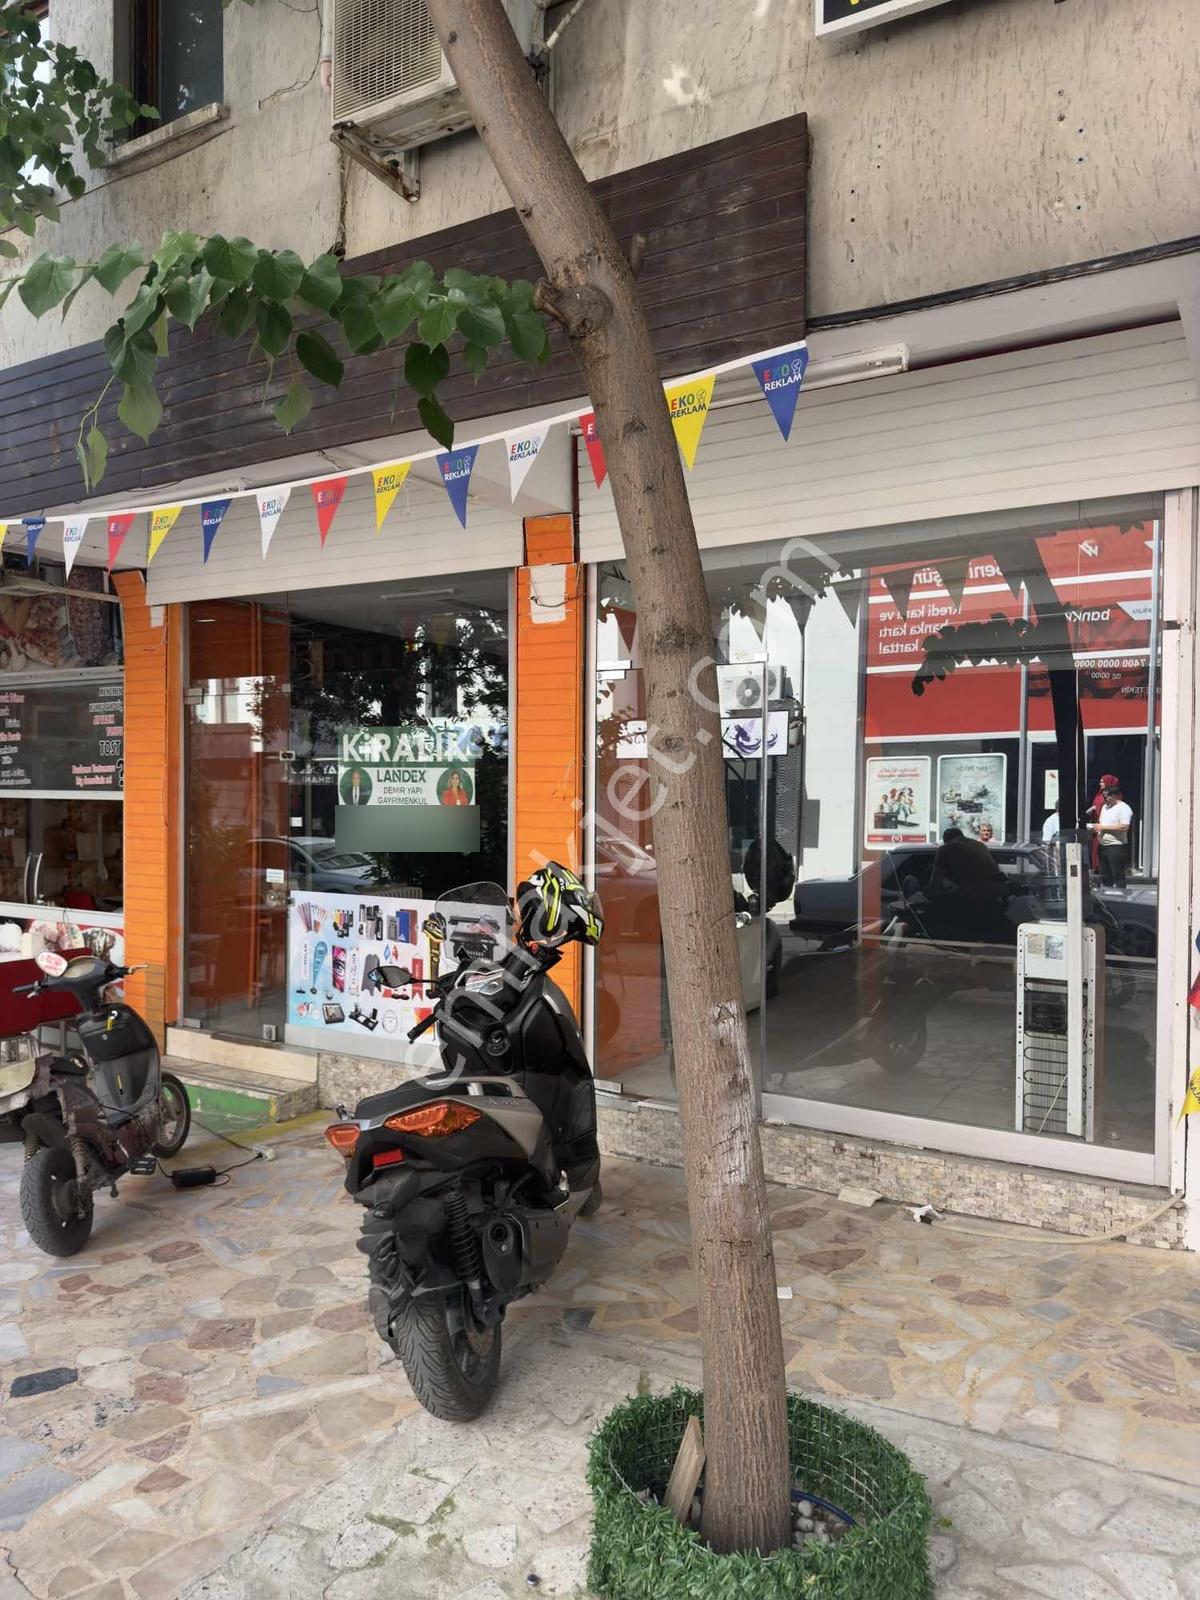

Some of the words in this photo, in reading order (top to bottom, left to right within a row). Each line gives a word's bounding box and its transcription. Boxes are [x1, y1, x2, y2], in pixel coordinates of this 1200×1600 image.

[764, 373, 802, 392] REKLAM
[671, 393, 695, 411] EKO
[671, 402, 707, 420] REKLAM
[511, 440, 531, 454] EKO
[509, 448, 538, 462] REKLAM
[377, 474, 396, 486] EKO
[444, 468, 471, 481] REKLAM
[376, 483, 400, 494] REKLAM
[262, 500, 277, 511] EKO
[261, 508, 282, 518] REKLAM
[99, 740, 121, 756] TOST
[376, 769, 427, 783] LANDEX
[407, 786, 423, 794] YAPI
